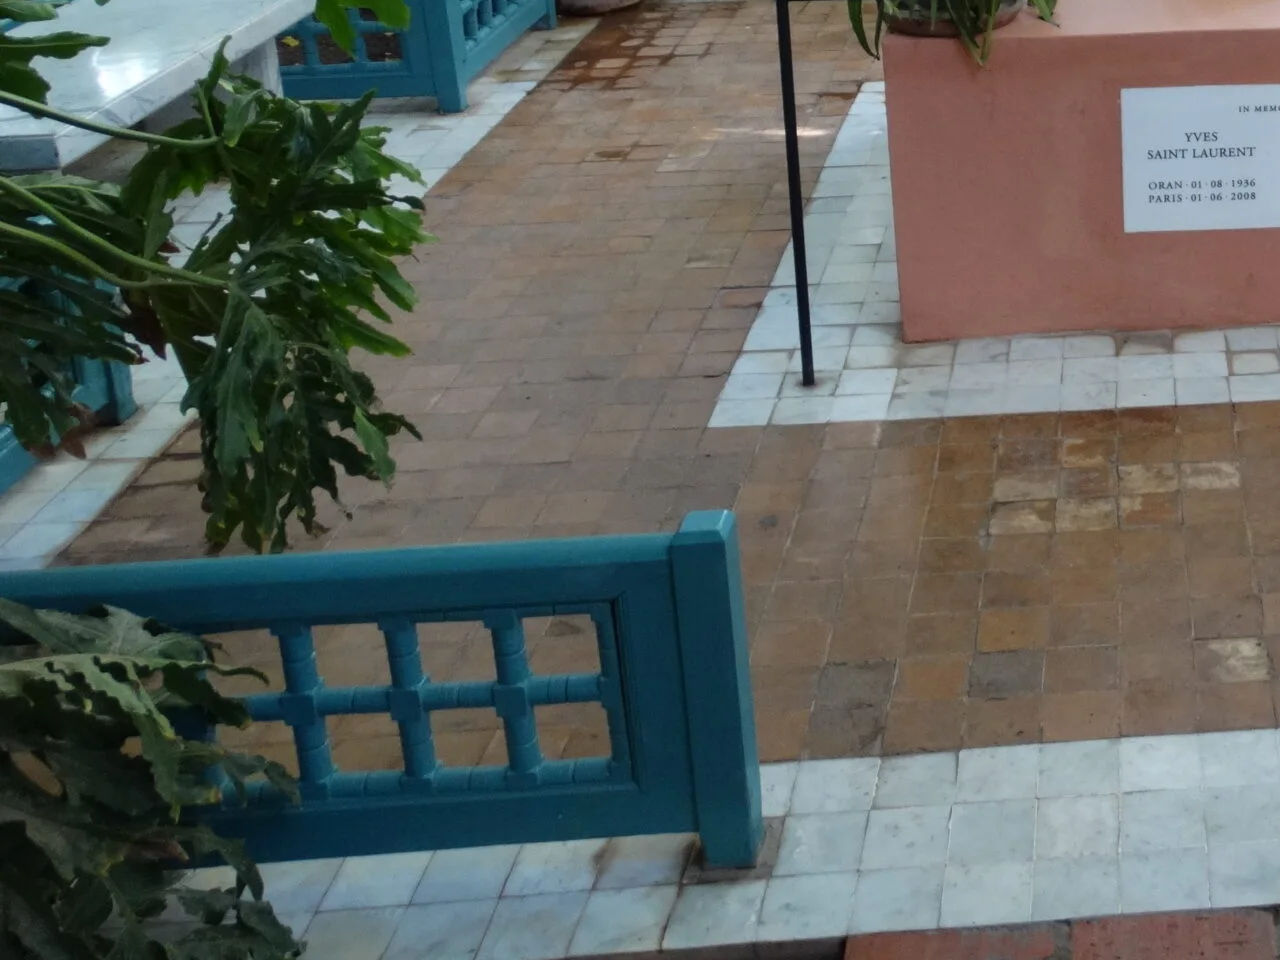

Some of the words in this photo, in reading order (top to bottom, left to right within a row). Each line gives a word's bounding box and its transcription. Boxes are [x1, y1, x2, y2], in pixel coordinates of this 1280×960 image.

[1238, 105, 1250, 113] IN
[1184, 131, 1218, 143] YVES
[1147, 148, 1189, 160] SAINT
[1192, 146, 1257, 159] LAURENT
[1148, 180, 1183, 191] ORAN
[1190, 180, 1202, 189] 01
[1210, 179, 1223, 189] 08
[1231, 178, 1256, 188] 1936
[1148, 193, 1183, 204] PARIS
[1190, 193, 1202, 203] 01
[1209, 192, 1223, 202] 06
[1230, 191, 1257, 201] 2008
